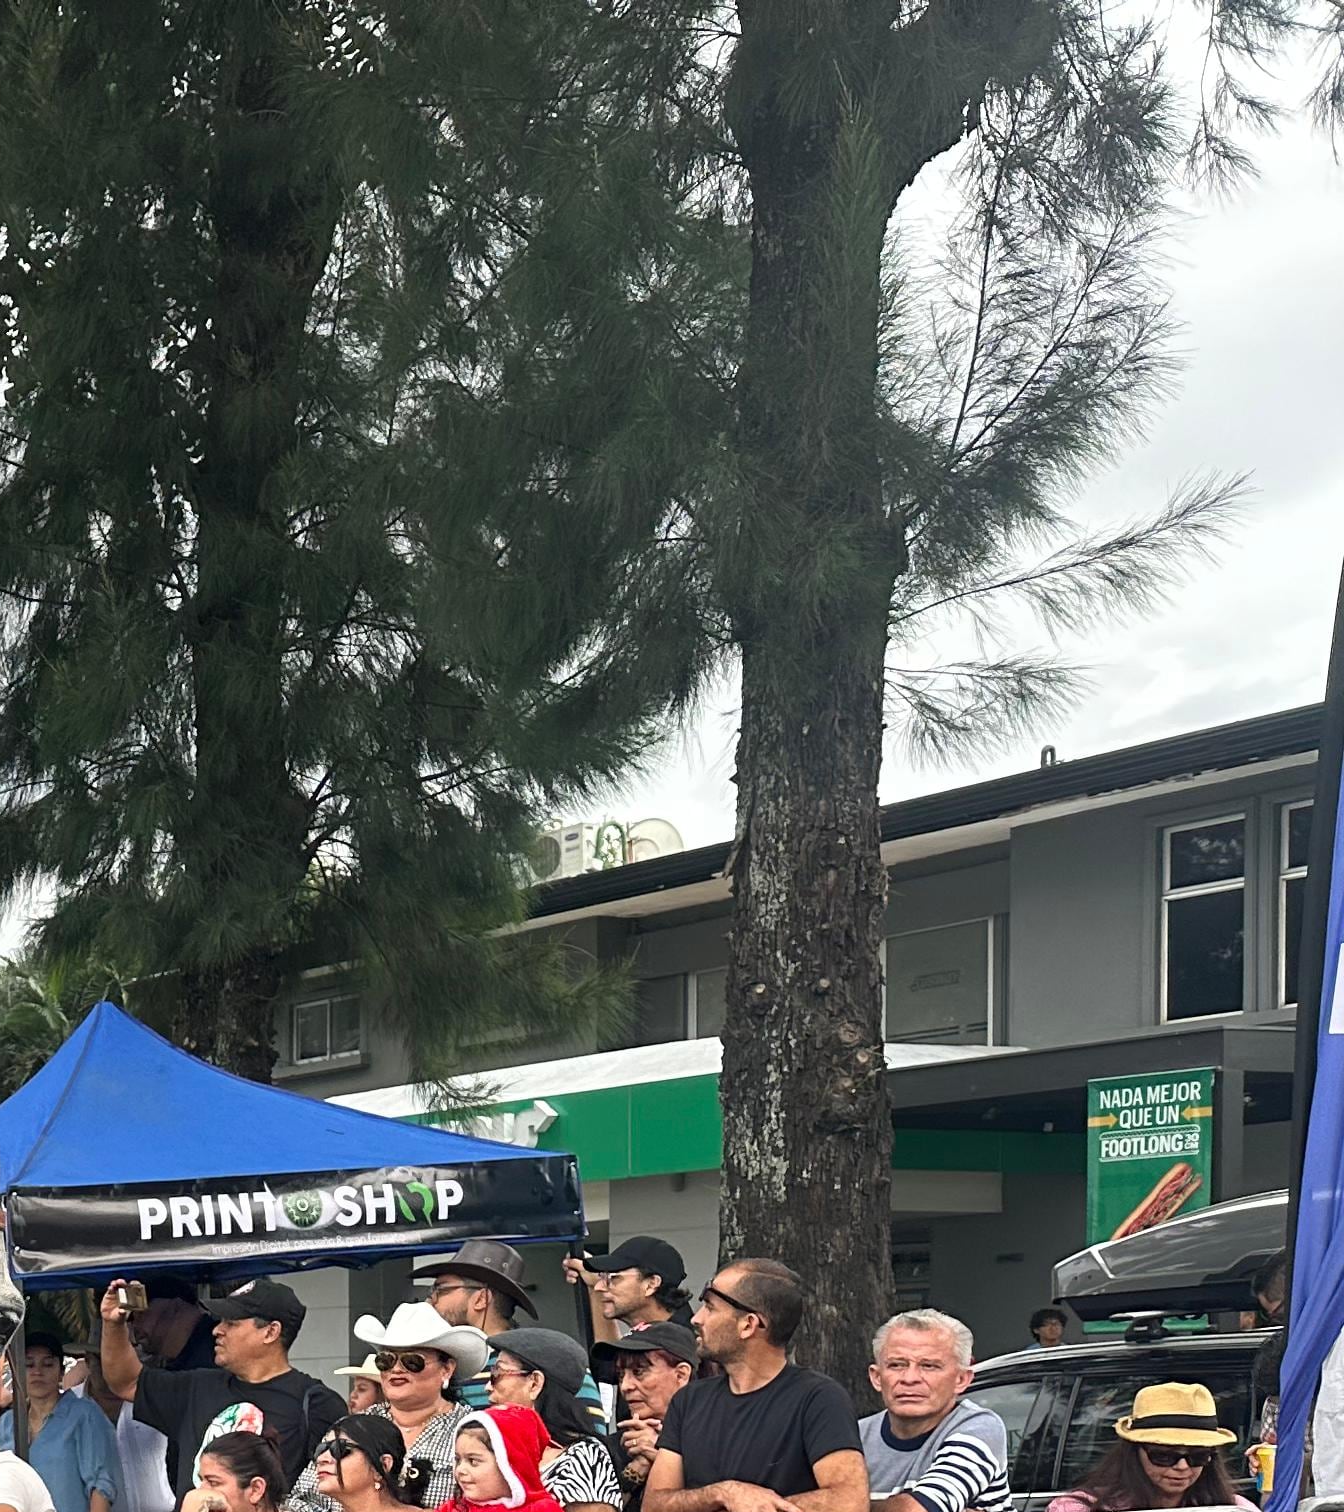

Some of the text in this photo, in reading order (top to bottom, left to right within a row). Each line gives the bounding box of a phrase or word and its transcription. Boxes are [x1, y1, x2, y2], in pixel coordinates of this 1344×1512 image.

[1099, 1081, 1202, 1109] NADA MEJOR
[1119, 1105, 1180, 1129] QUE UN
[1100, 1133, 1183, 1157] FOOTLONG
[137, 1182, 278, 1240] PRINT
